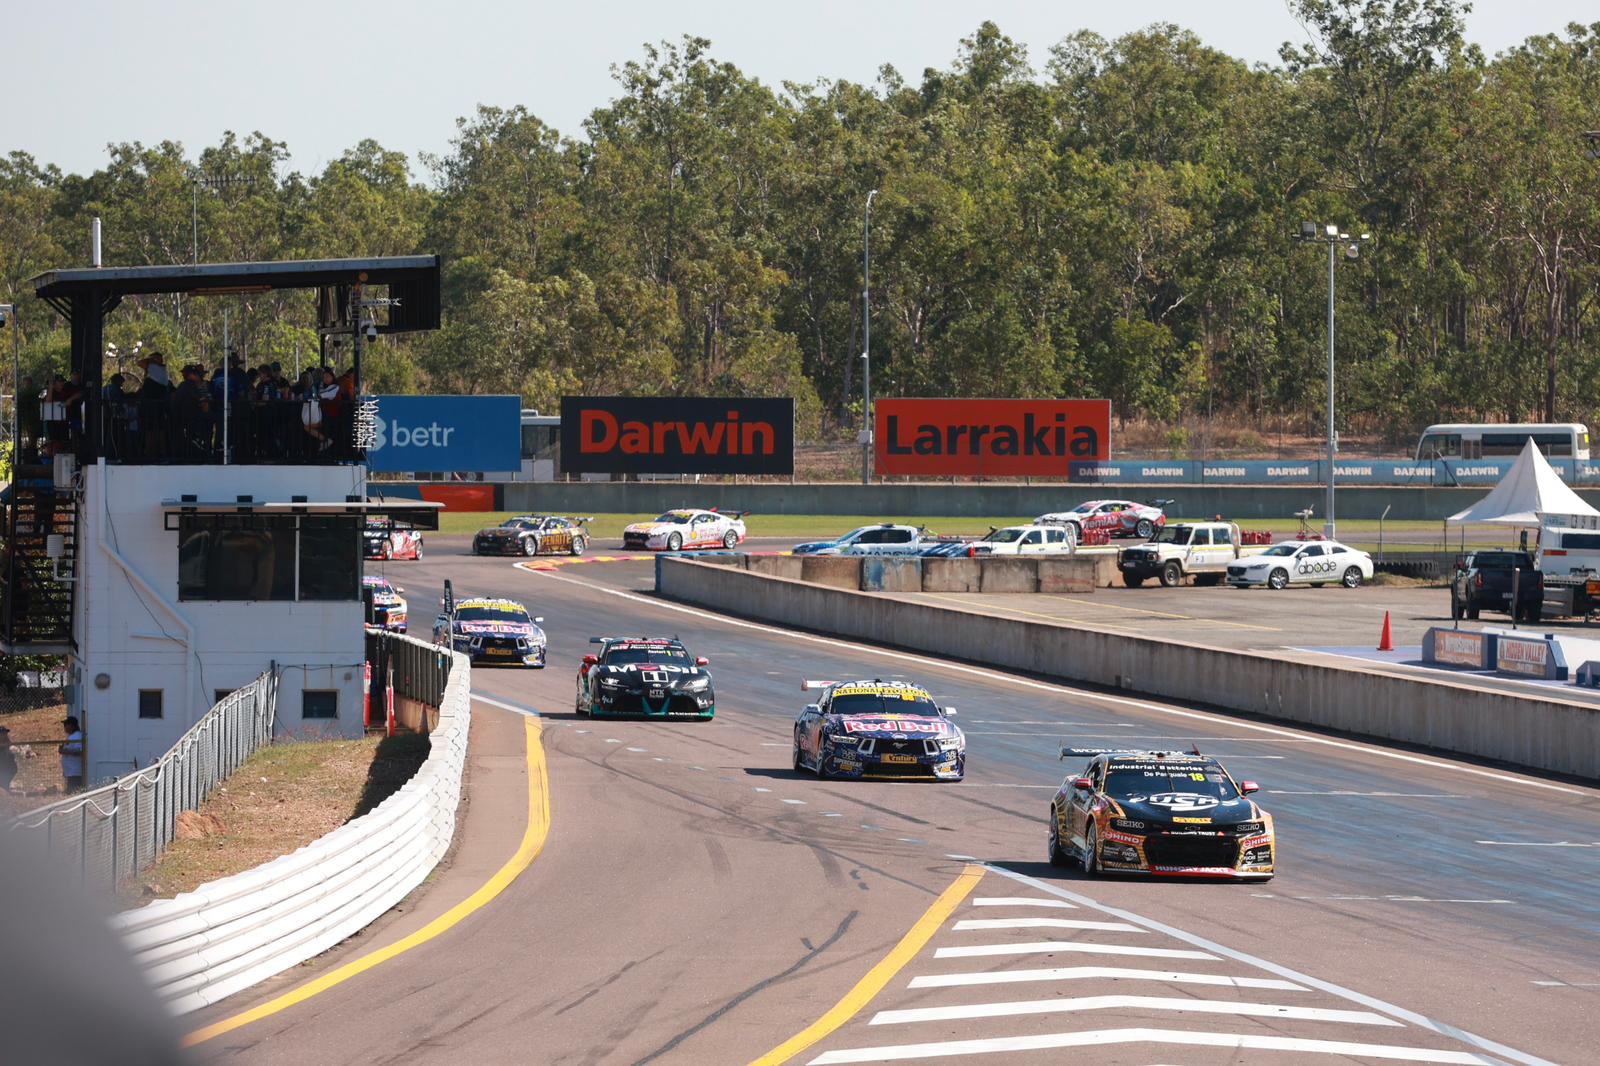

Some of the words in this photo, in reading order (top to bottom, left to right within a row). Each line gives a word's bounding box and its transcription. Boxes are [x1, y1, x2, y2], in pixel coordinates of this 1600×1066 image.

[392, 419, 455, 447] betr
[580, 409, 775, 455] Darwin
[886, 413, 1099, 456] Larrakia
[1079, 467, 1121, 477] DARWIN
[1142, 467, 1184, 477] DARWIN
[1203, 467, 1246, 477] DARWIN
[1267, 466, 1309, 476] DARWIN
[1332, 466, 1372, 476] DARWIN
[1394, 467, 1436, 477] DARWIN
[1456, 466, 1499, 477] DARWIN
[542, 534, 571, 545] PENRITE
[1298, 560, 1337, 575] abode
[1505, 640, 1525, 660] HIDDEN
[1525, 642, 1545, 662] VALLEY
[608, 664, 698, 674] Mobil
[843, 720, 898, 733] Red
[898, 720, 948, 734] Bull
[1189, 772, 1205, 781] 18
[1117, 819, 1145, 829] SEIKO
[1237, 823, 1260, 832] SEIKO
